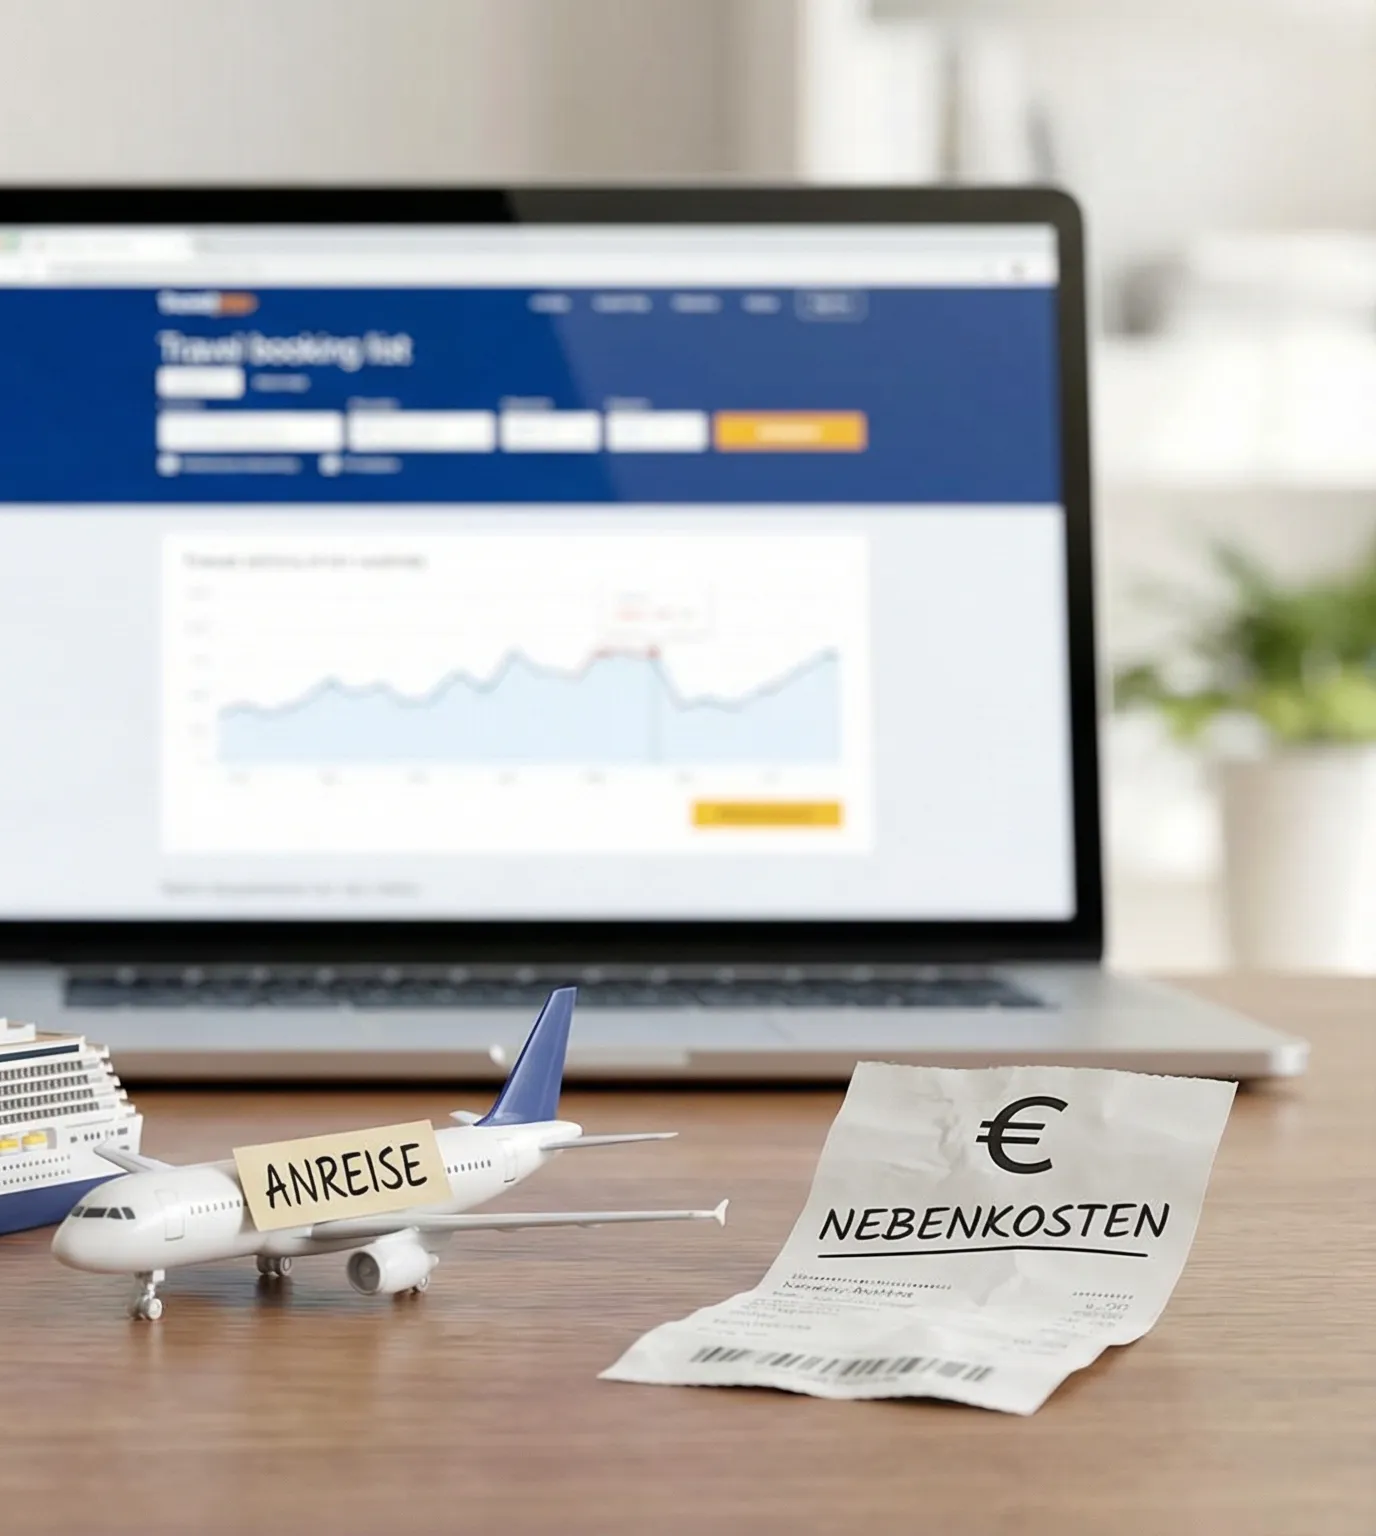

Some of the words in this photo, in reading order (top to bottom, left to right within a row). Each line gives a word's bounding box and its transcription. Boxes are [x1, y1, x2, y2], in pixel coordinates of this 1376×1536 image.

[250, 331, 361, 370] booking
[975, 1095, 1069, 1175] €
[265, 1143, 428, 1210] ANREISE
[818, 1202, 1171, 1242] NEBENKOSTEN
